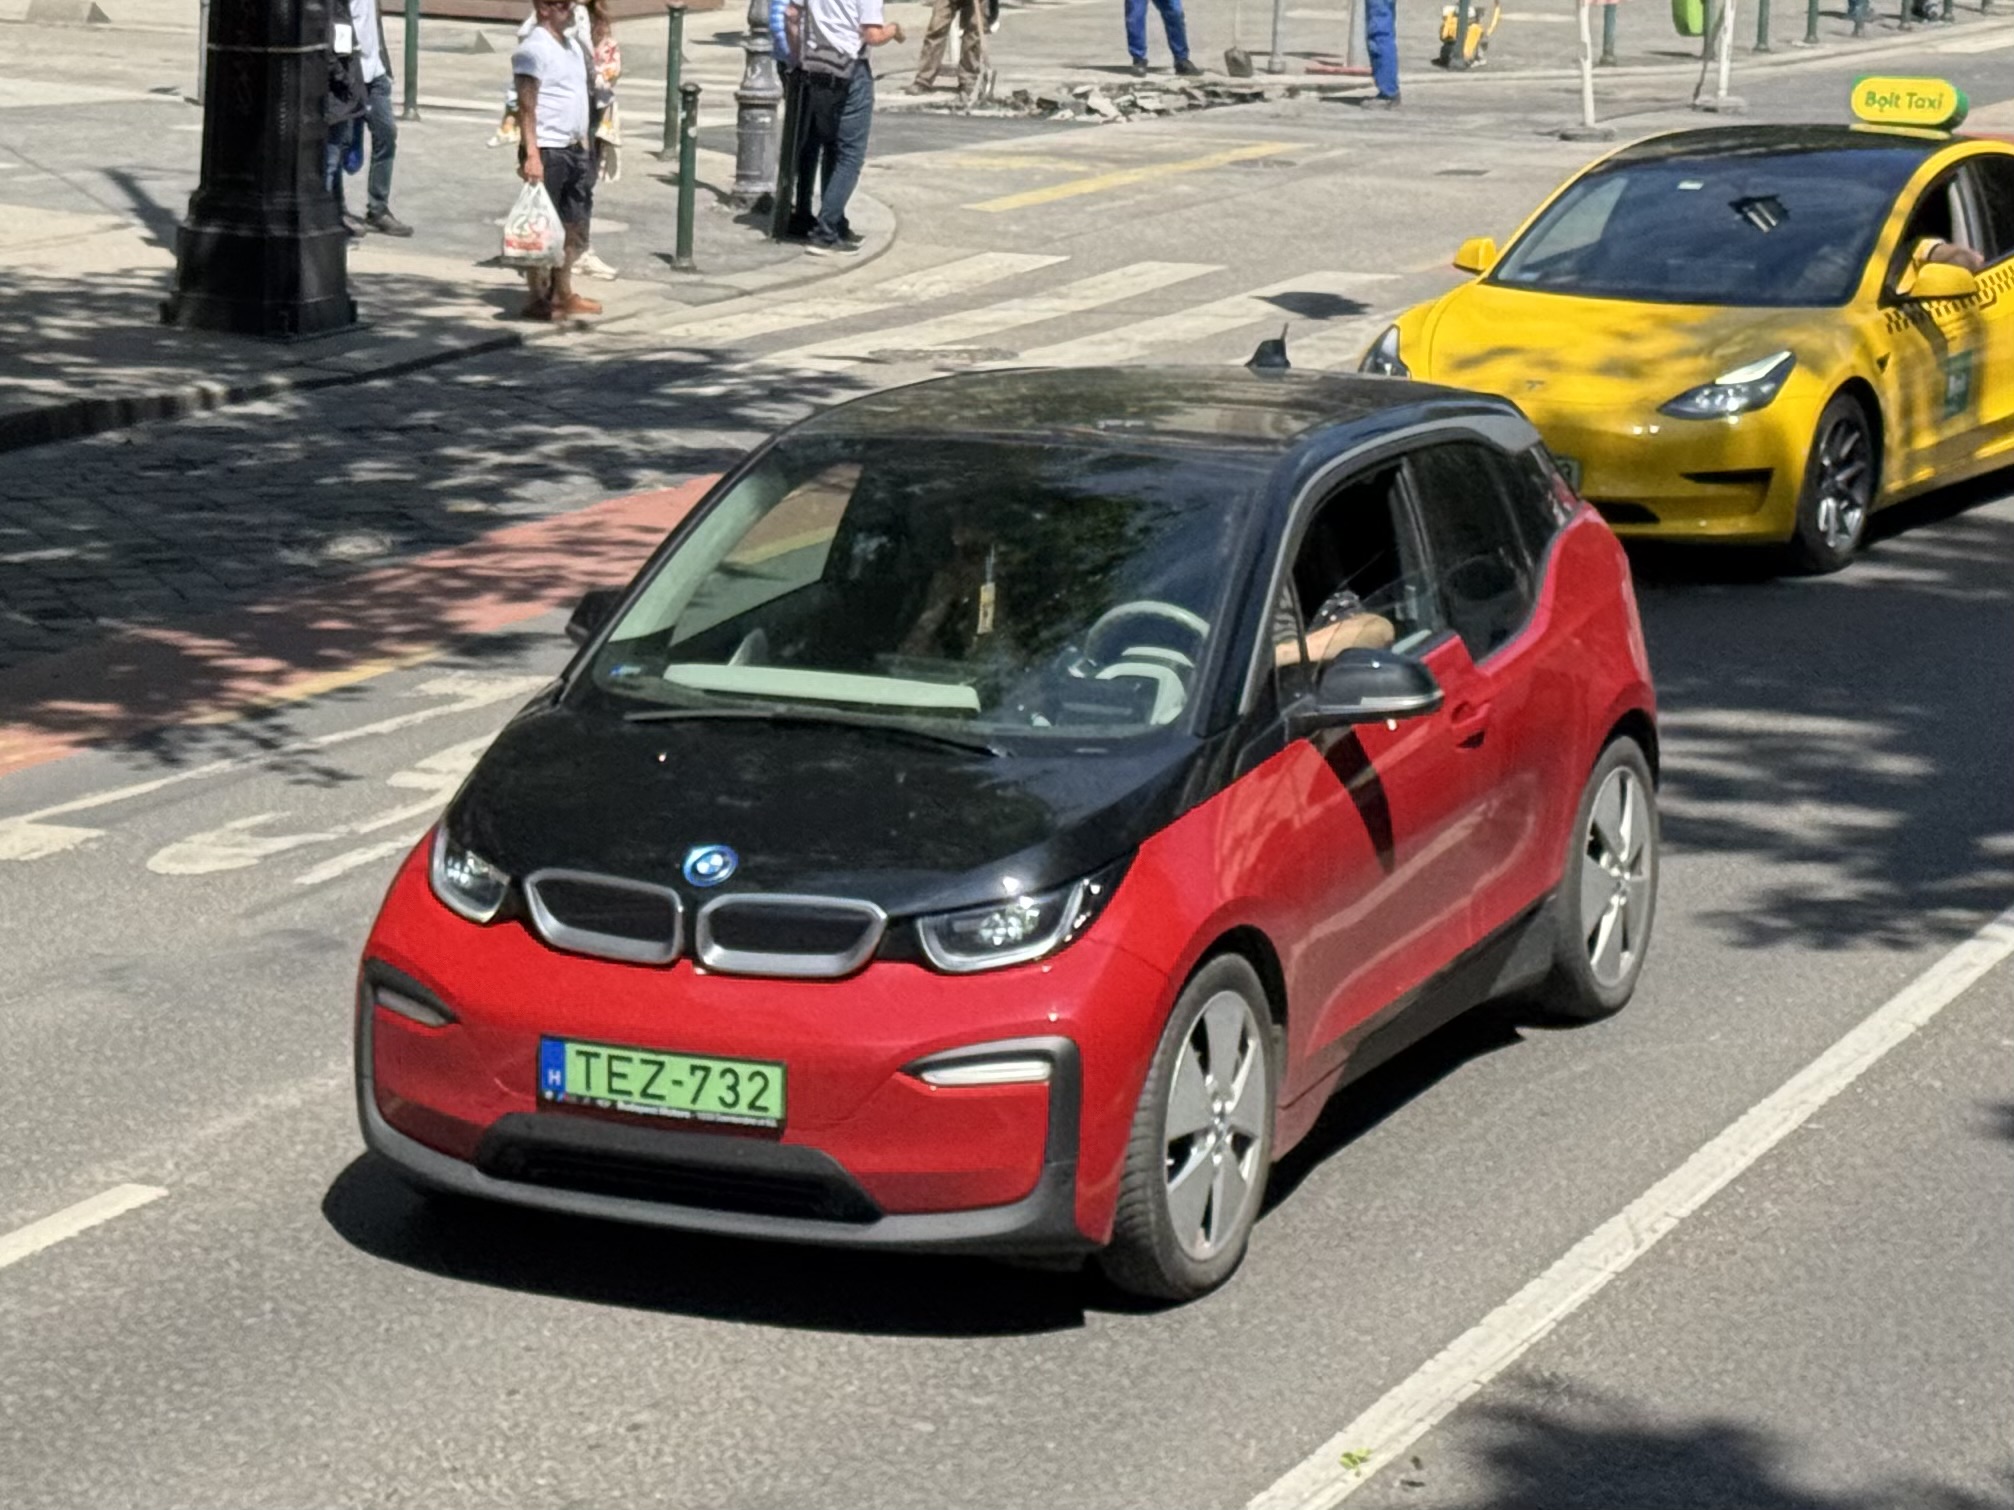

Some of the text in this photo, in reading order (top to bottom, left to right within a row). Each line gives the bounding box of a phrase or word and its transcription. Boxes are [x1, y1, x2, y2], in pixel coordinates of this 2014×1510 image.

[1864, 90, 1944, 112] Bolt Taxi
[547, 1069, 561, 1087] H
[575, 1049, 770, 1113] TEZ-732
